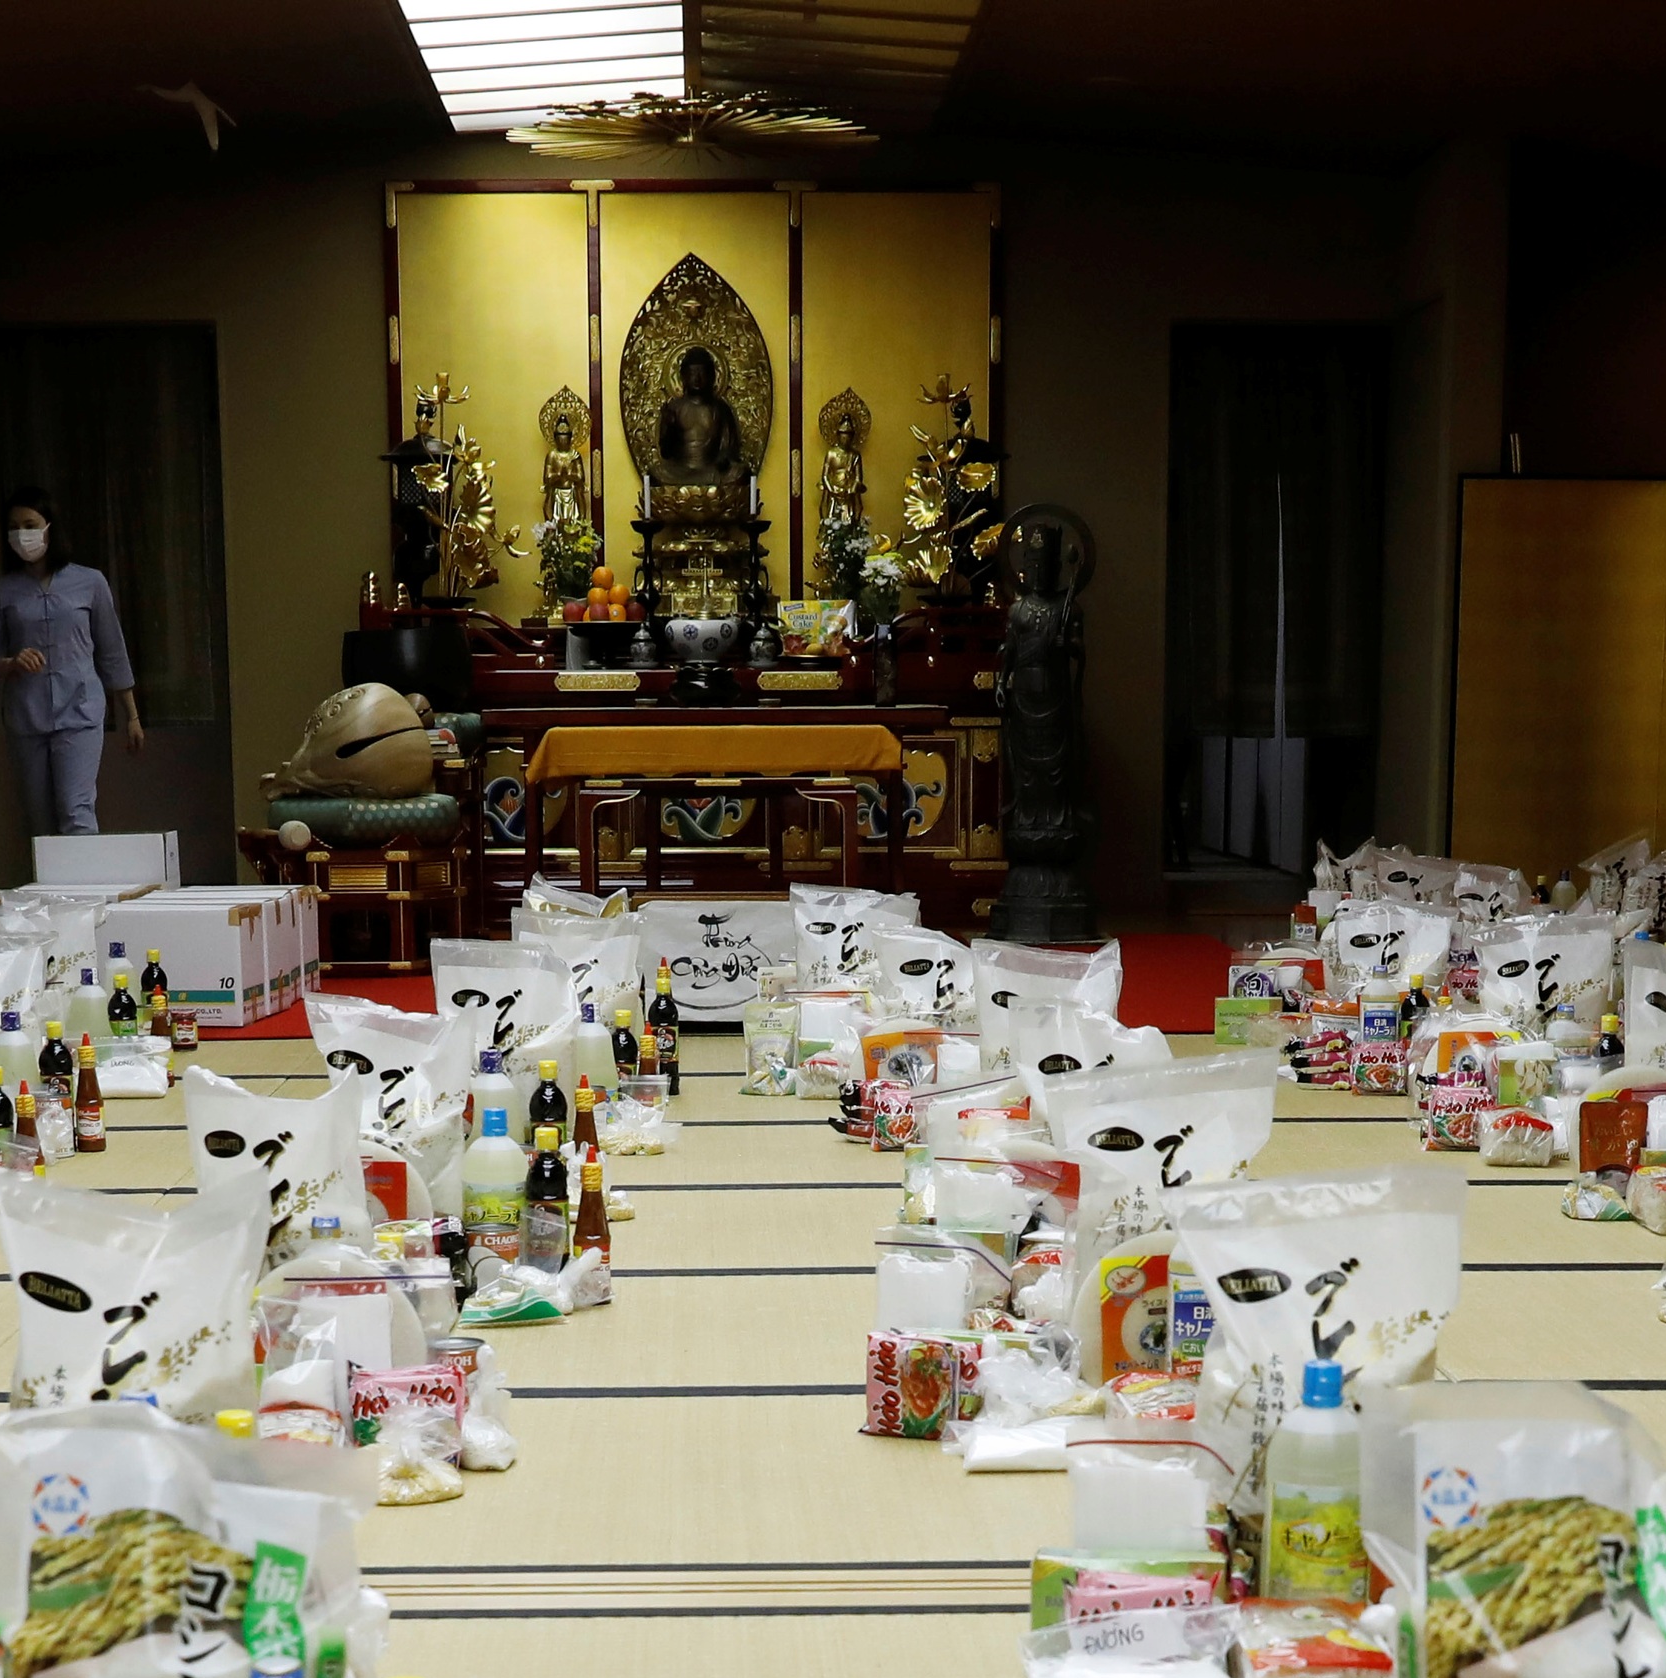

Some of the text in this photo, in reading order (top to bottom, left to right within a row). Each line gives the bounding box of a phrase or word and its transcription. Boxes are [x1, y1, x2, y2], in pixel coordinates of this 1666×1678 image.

[787, 612, 818, 620] Custard
[792, 620, 813, 628] Cake
[219, 977, 235, 989] 10
[1373, 1017, 1388, 1027] 日清
[1082, 1621, 1145, 1655] ĐƯỜNG
